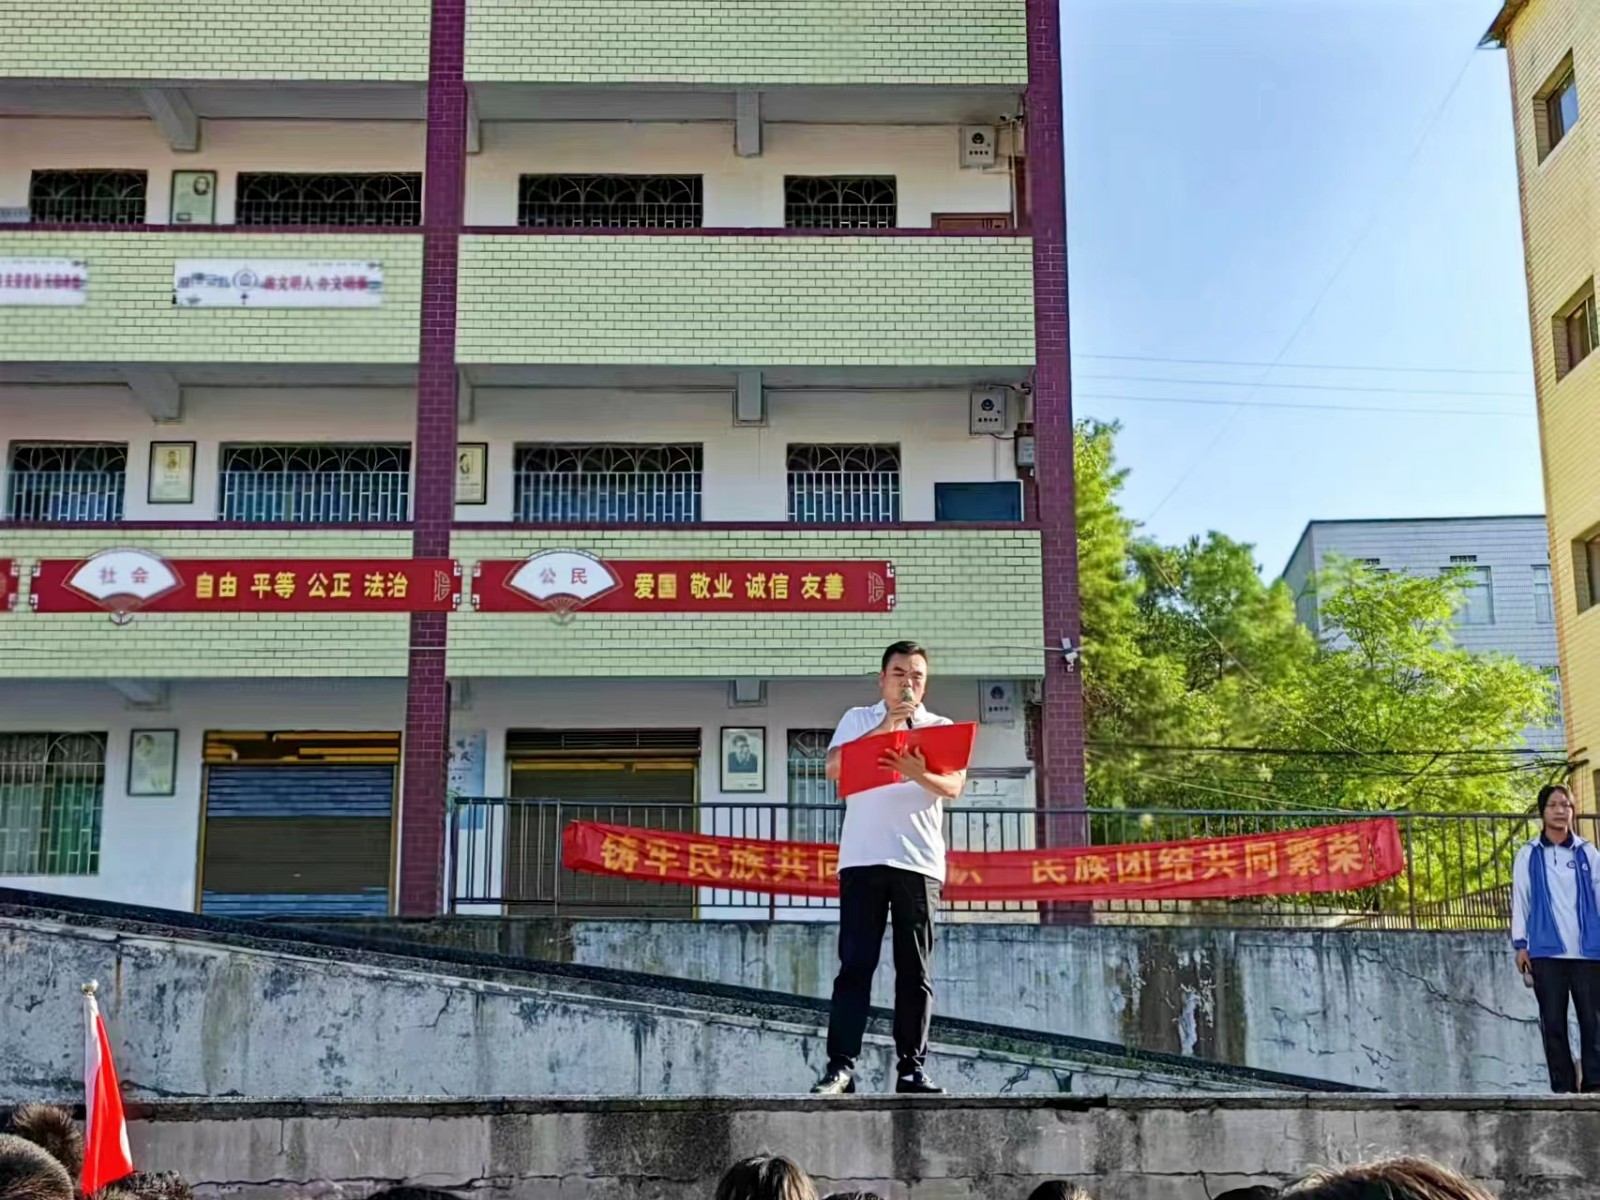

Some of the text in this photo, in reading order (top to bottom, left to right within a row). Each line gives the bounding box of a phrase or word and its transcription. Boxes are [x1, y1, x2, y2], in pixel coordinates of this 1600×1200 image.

[99, 566, 149, 585] 社会
[196, 572, 409, 599] 自由 平等 公正 法治
[540, 567, 588, 585] 公民
[634, 573, 845, 600] 爱国 敬业 诚信 友善
